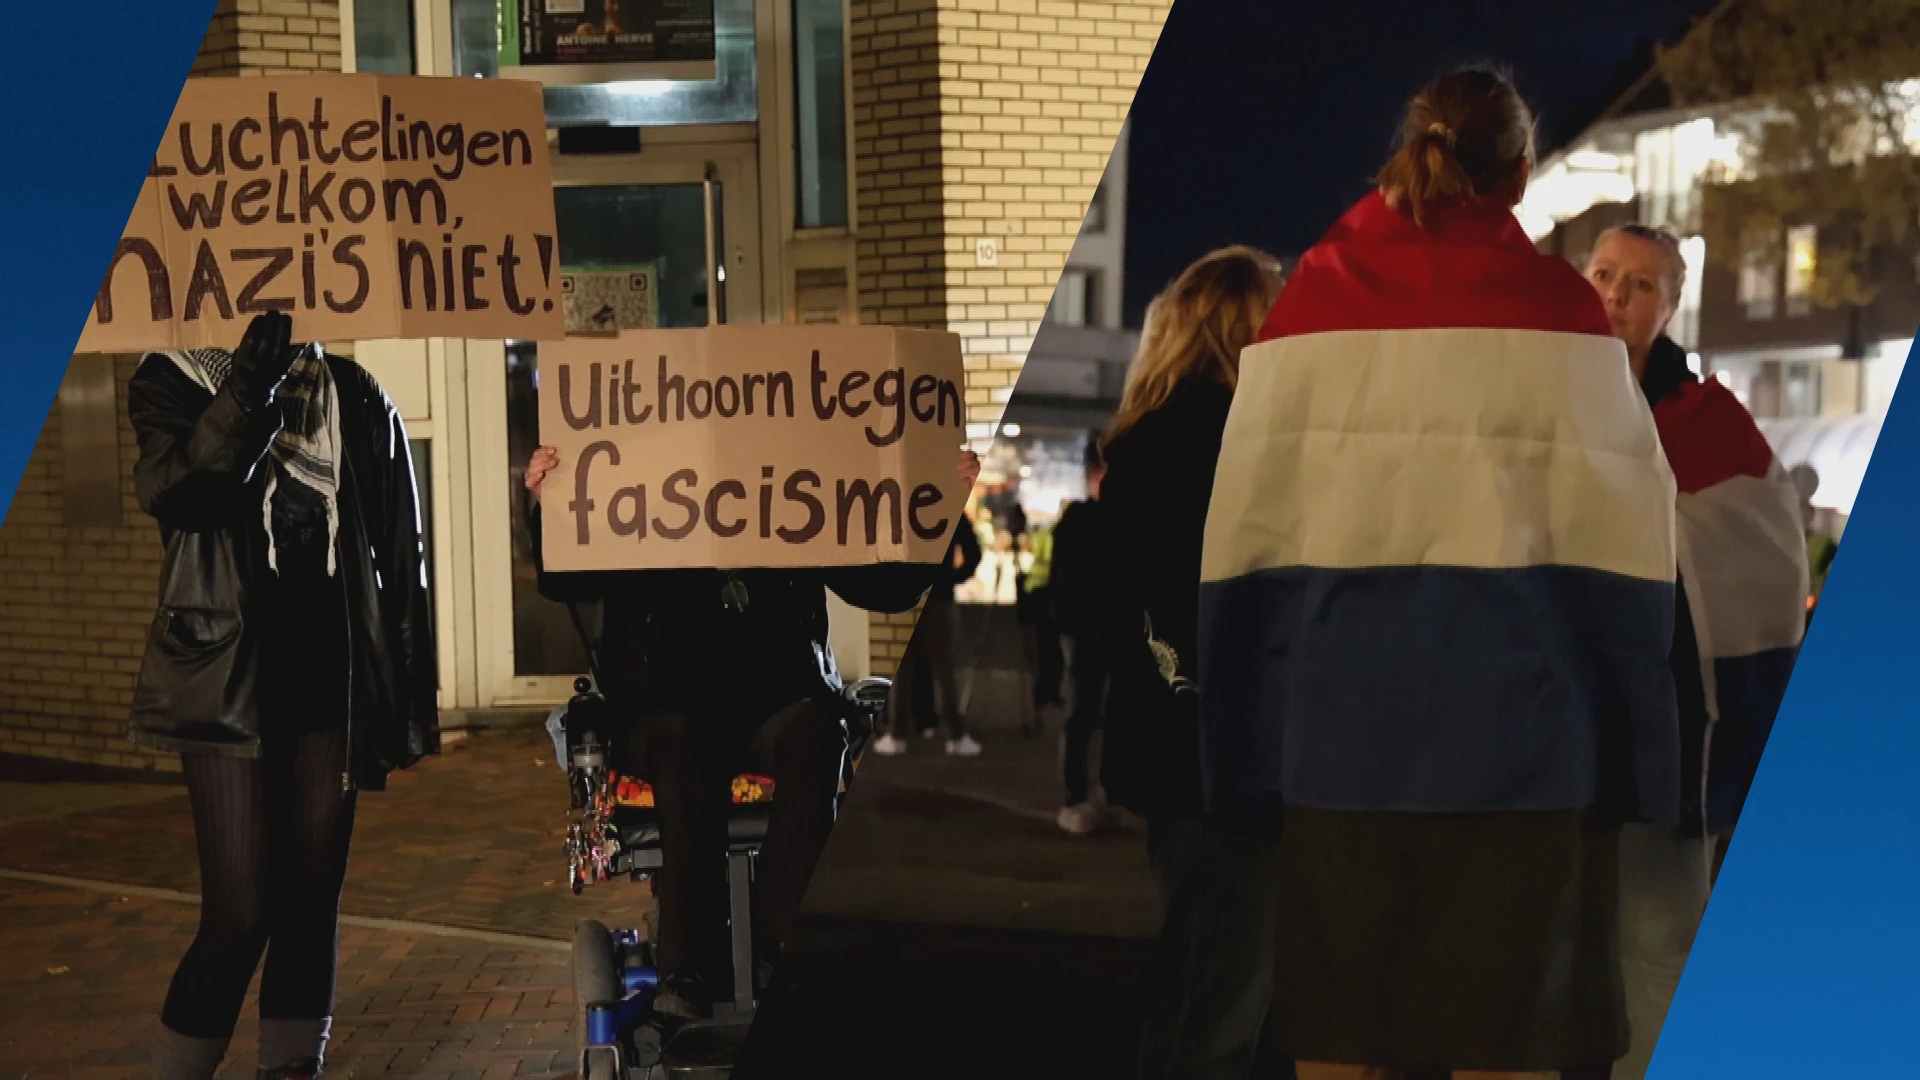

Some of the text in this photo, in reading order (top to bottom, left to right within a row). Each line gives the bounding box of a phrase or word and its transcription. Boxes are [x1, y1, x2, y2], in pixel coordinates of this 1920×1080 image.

[979, 244, 994, 260] 10
[558, 349, 961, 446] Uithoorn tegen
[569, 440, 949, 547] fascisme
